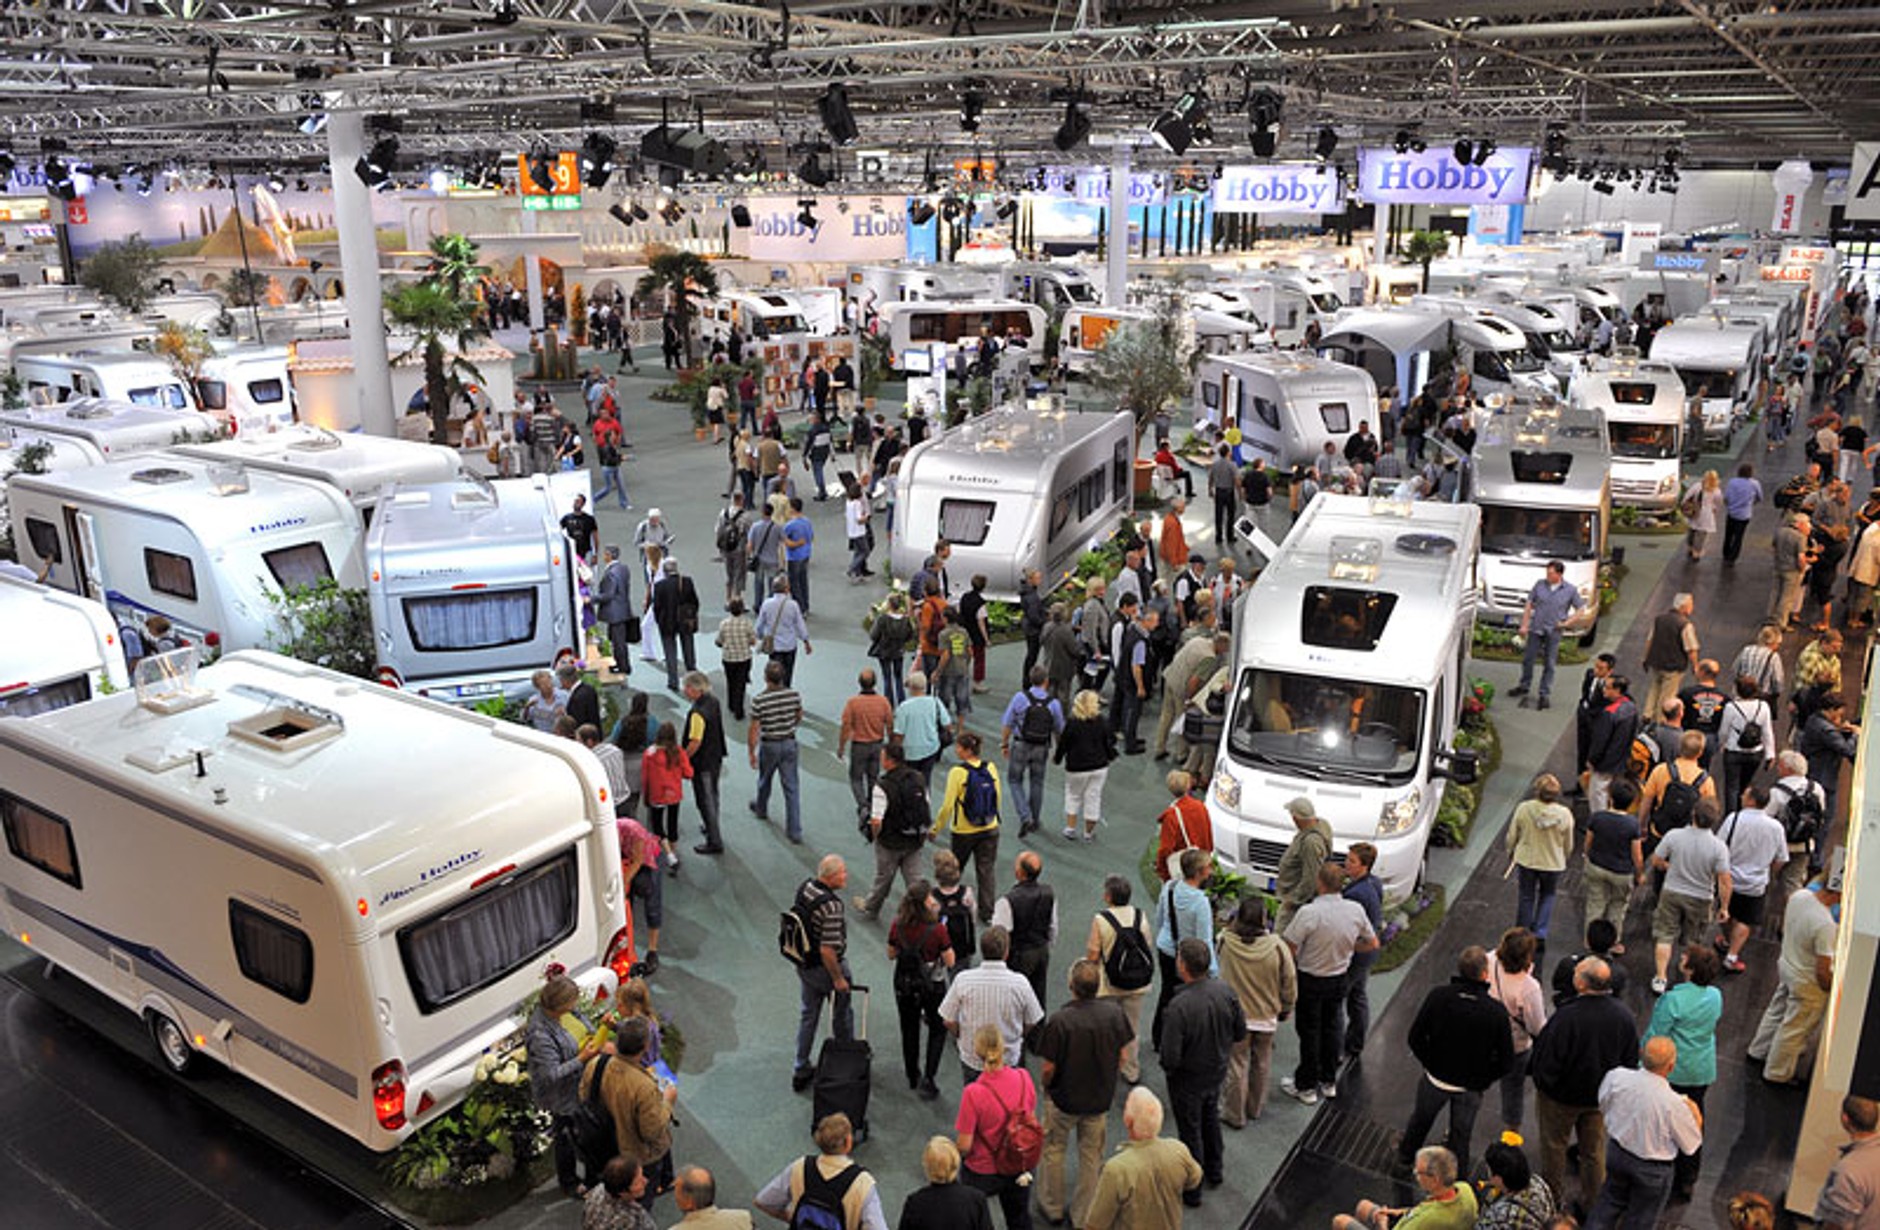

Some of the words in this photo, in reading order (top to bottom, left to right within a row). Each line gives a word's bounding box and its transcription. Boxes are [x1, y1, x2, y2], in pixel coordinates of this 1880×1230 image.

[1226, 176, 1328, 208] Hobby
[1378, 159, 1515, 199] Hobby
[752, 213, 824, 243] obby
[1654, 254, 1708, 273] Hobby
[420, 849, 483, 881] Hobby
